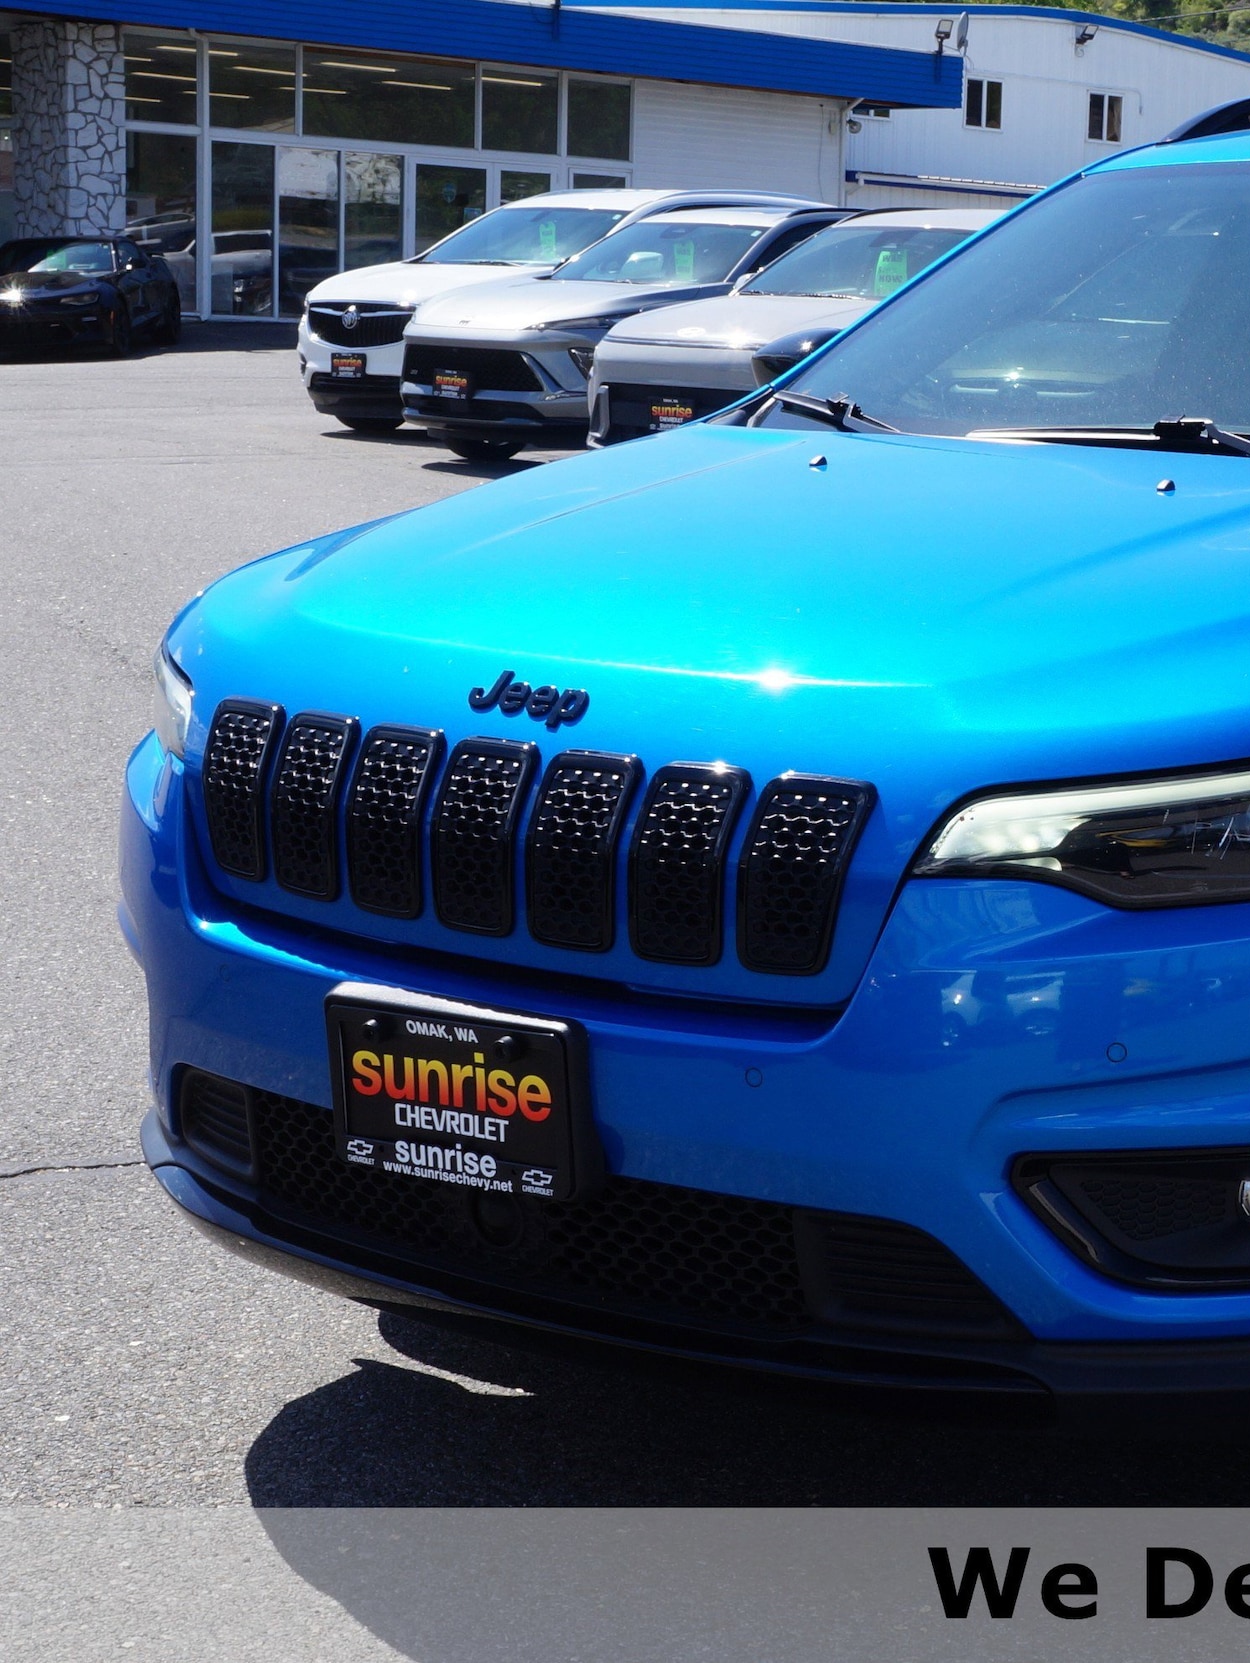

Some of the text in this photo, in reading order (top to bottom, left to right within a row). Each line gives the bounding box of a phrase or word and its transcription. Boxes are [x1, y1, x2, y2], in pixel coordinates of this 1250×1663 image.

[651, 404, 692, 418] sunrise
[468, 670, 590, 730] Jeep
[406, 1020, 479, 1044] OMAK, WA
[352, 1050, 552, 1122] sunrise
[394, 1103, 509, 1142] CHEVROLET
[383, 1161, 513, 1193] www.sunrisechevy.net
[395, 1140, 497, 1177] sunrise
